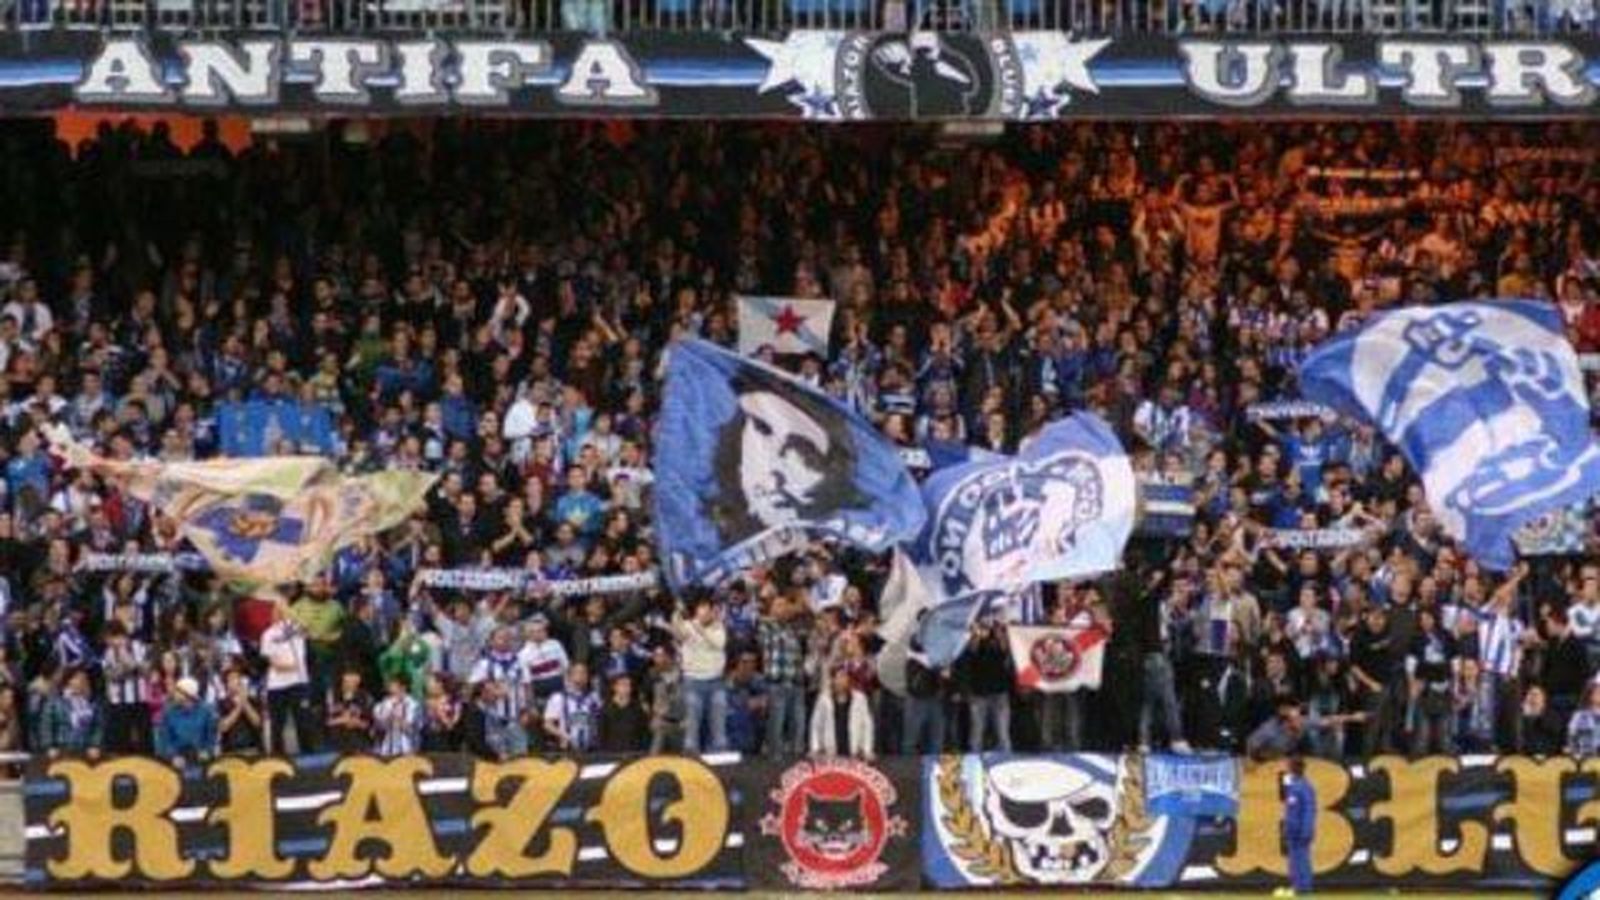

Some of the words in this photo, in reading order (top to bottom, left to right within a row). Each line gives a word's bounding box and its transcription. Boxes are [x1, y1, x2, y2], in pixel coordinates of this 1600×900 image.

[76, 39, 657, 103] ANTIFA
[1178, 40, 1597, 106] ULTR
[46, 755, 730, 880] RIAZO
